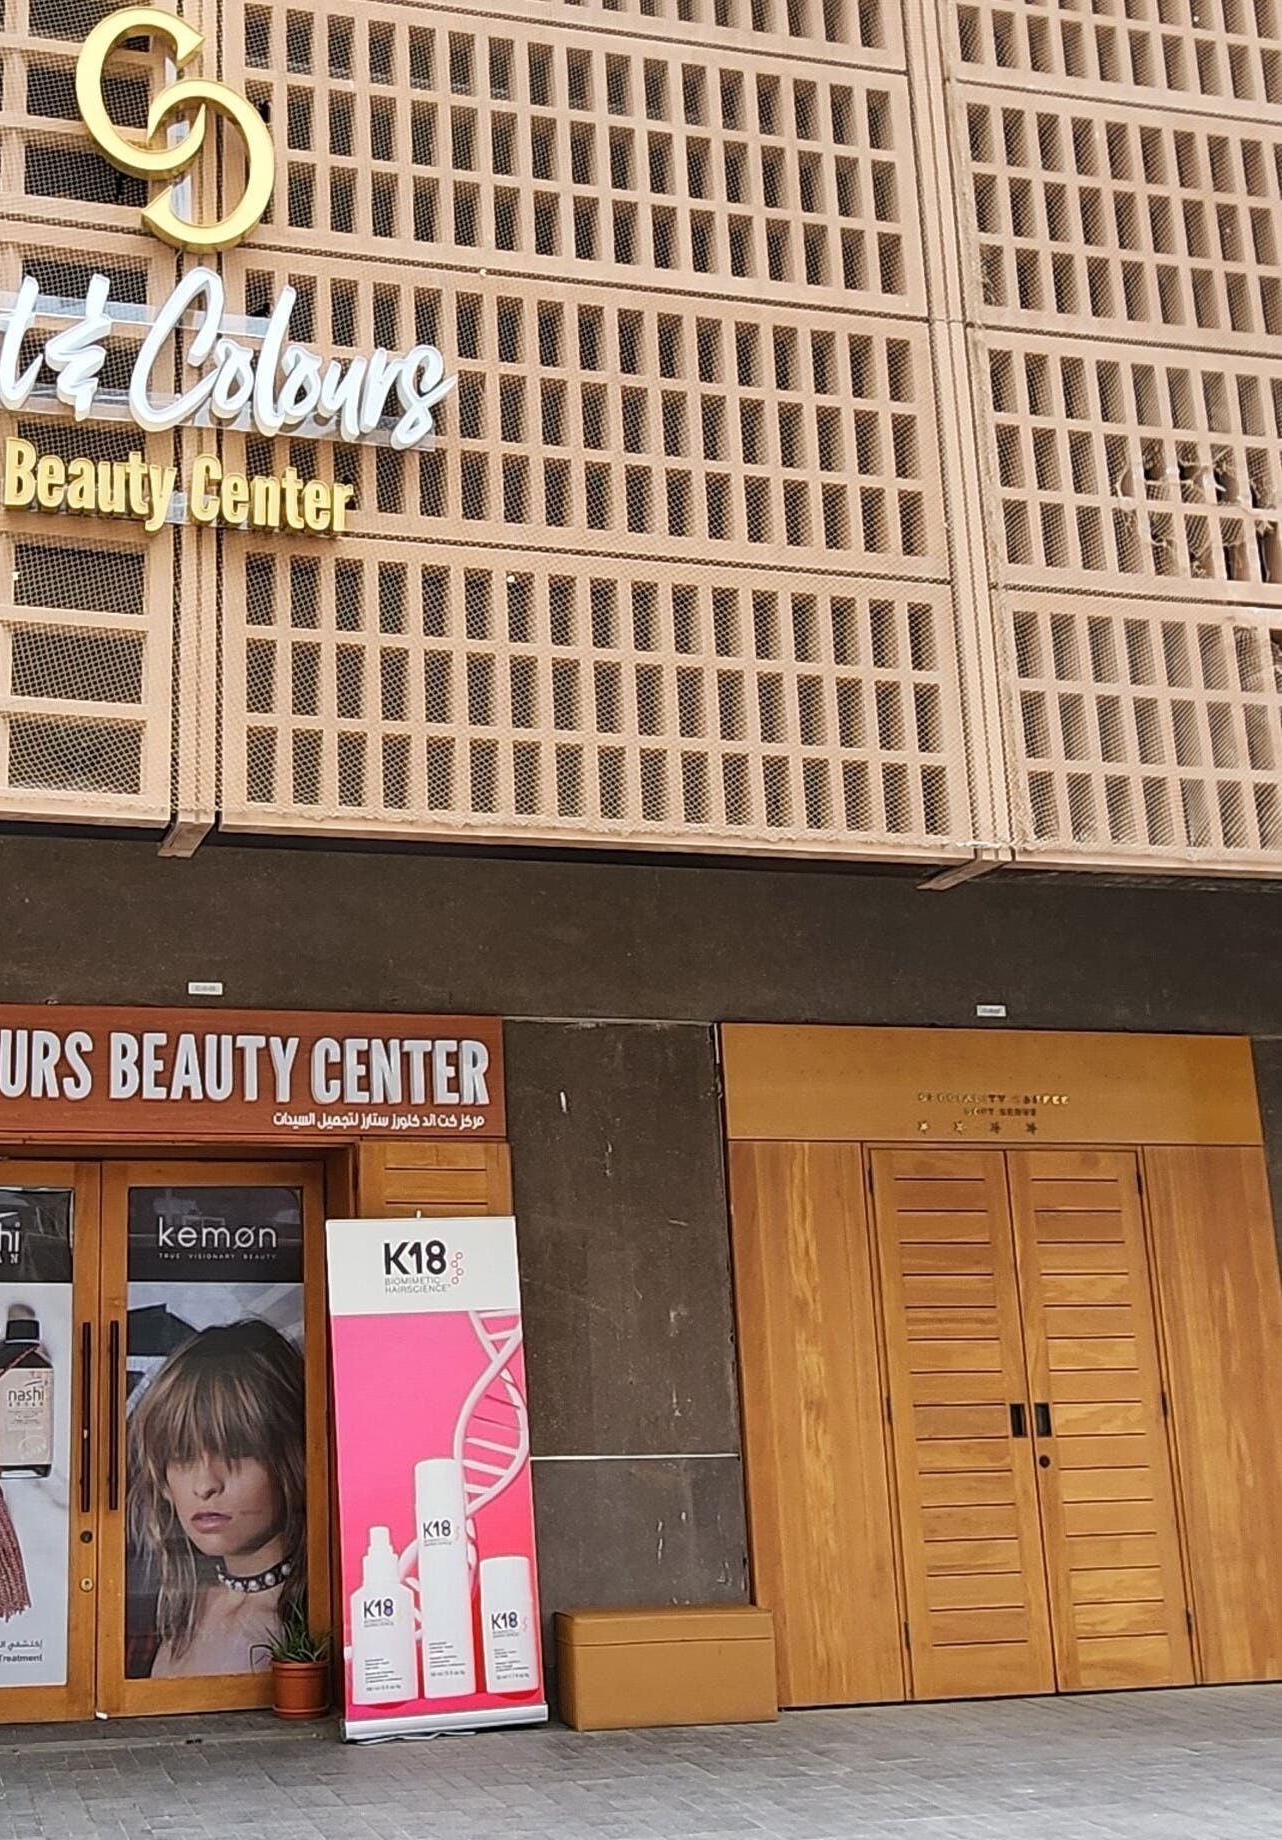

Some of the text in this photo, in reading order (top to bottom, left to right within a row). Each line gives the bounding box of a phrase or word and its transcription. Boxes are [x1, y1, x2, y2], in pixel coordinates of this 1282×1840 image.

[45, 273, 112, 421] &
[129, 266, 456, 450] Colours
[3, 436, 354, 532] Beauty Center
[109, 1032, 300, 1103] BEAUTY
[310, 1037, 490, 1105] CENTER
[273, 1112, 316, 1129] السيدات
[318, 1112, 358, 1129] لتجميل
[437, 1113, 458, 1127] كت
[459, 1113, 485, 1131] مركز
[383, 1239, 446, 1275] K18
[384, 1276, 441, 1286] BIOMIMETIC
[8, 1386, 44, 1401] nashi
[423, 1519, 452, 1539] K18
[363, 1598, 394, 1618] K18
[491, 1611, 518, 1630] K18
